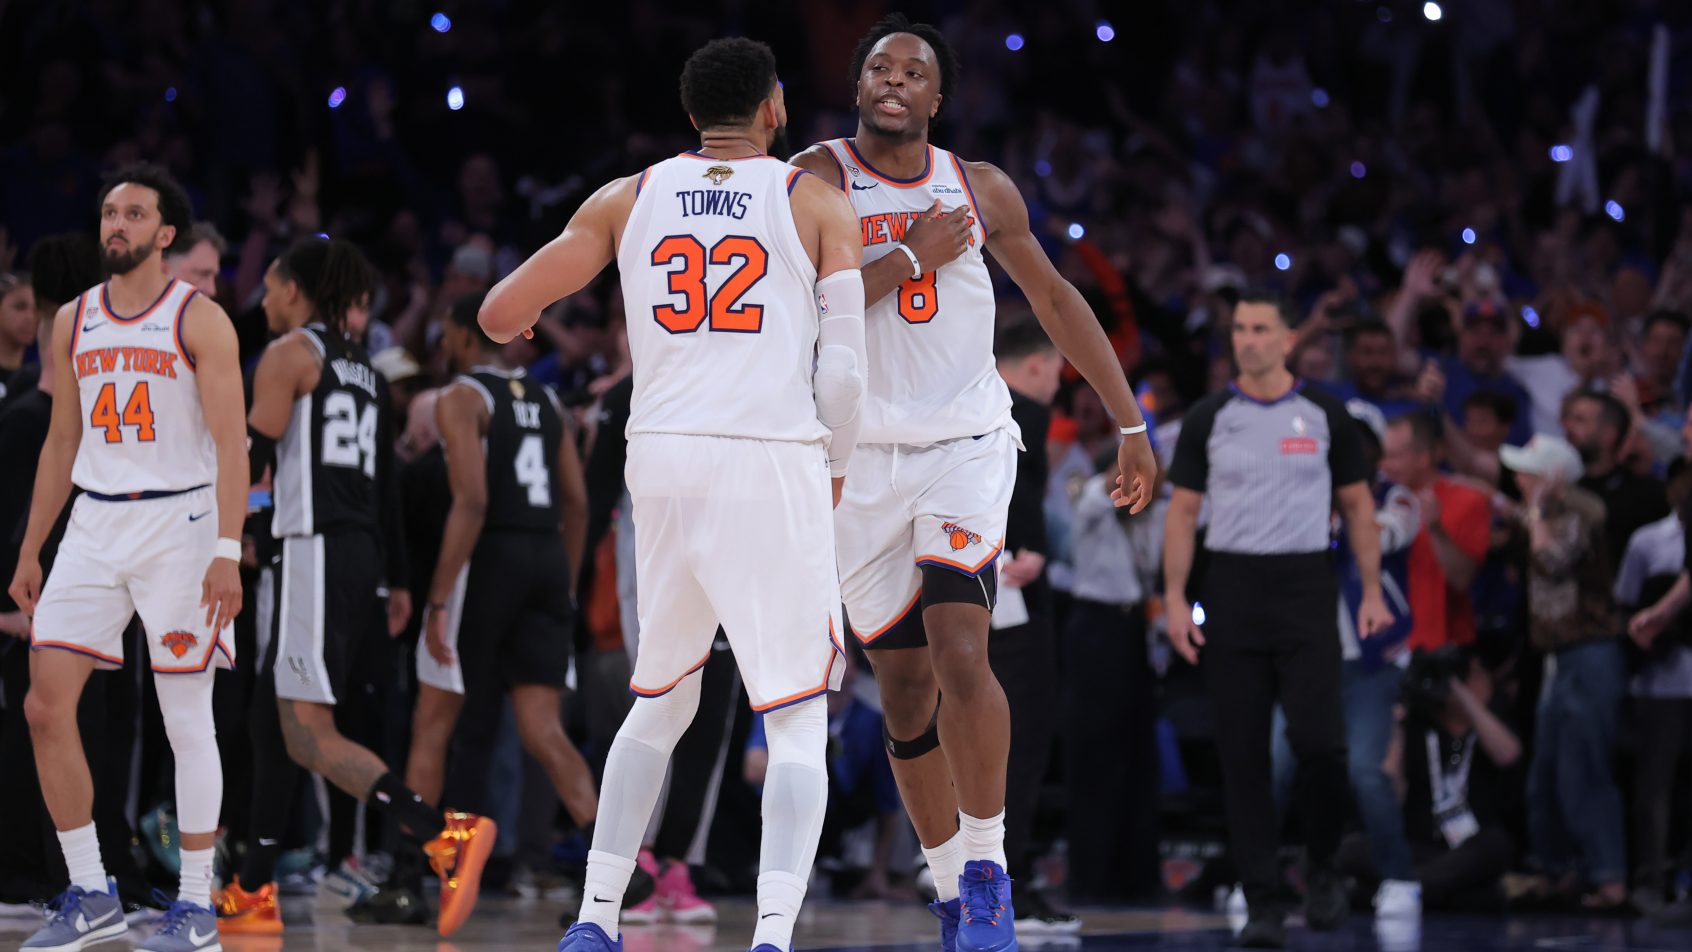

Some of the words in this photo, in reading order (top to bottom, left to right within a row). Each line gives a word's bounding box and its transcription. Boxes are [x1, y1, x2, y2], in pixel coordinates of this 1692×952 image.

[676, 189, 753, 220] TOWNS
[651, 234, 769, 334] 32
[898, 269, 939, 324] 8
[76, 347, 120, 380] NEW
[120, 346, 177, 380] YORK
[91, 381, 155, 443] 44
[321, 389, 379, 479] 24
[514, 433, 552, 507] 4
